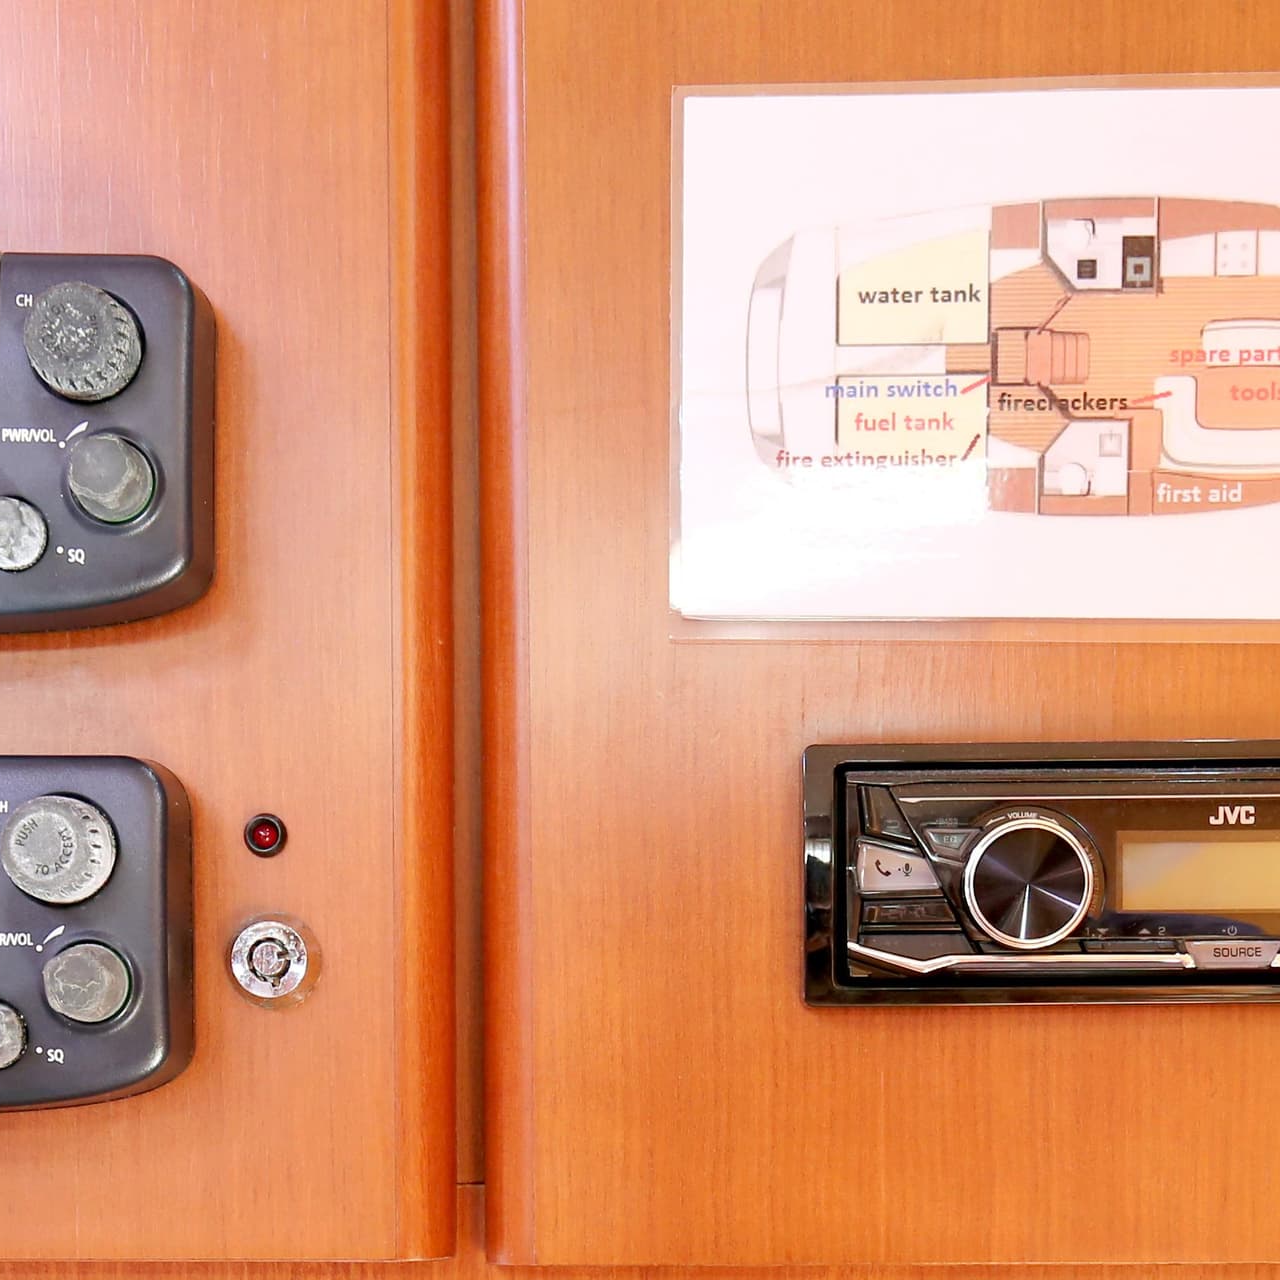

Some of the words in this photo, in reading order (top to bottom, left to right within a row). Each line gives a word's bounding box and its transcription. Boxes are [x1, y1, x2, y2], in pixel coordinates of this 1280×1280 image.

[16, 294, 33, 307] CH
[858, 288, 923, 304] water
[930, 286, 981, 304] tank
[1169, 346, 1233, 364] spare
[825, 381, 879, 398] main
[887, 378, 958, 398] switch
[998, 393, 1129, 412] firecrackers
[854, 412, 896, 432] fuel
[904, 411, 955, 432] tank
[1, 428, 57, 444] PWR/VOL
[776, 450, 813, 469] fire
[821, 449, 958, 470] extinguisher
[1157, 484, 1203, 504] first
[1208, 484, 1243, 504] aid
[67, 548, 86, 565] SQ
[1007, 811, 1039, 820] VOLUME
[1209, 805, 1256, 825] JVC
[15, 819, 38, 847] PUSH
[34, 863, 50, 876] TO
[54, 828, 74, 873] ACCEPT
[1158, 926, 1167, 936] 2
[1213, 946, 1262, 958] SOURCE
[46, 1048, 65, 1064] SQ
